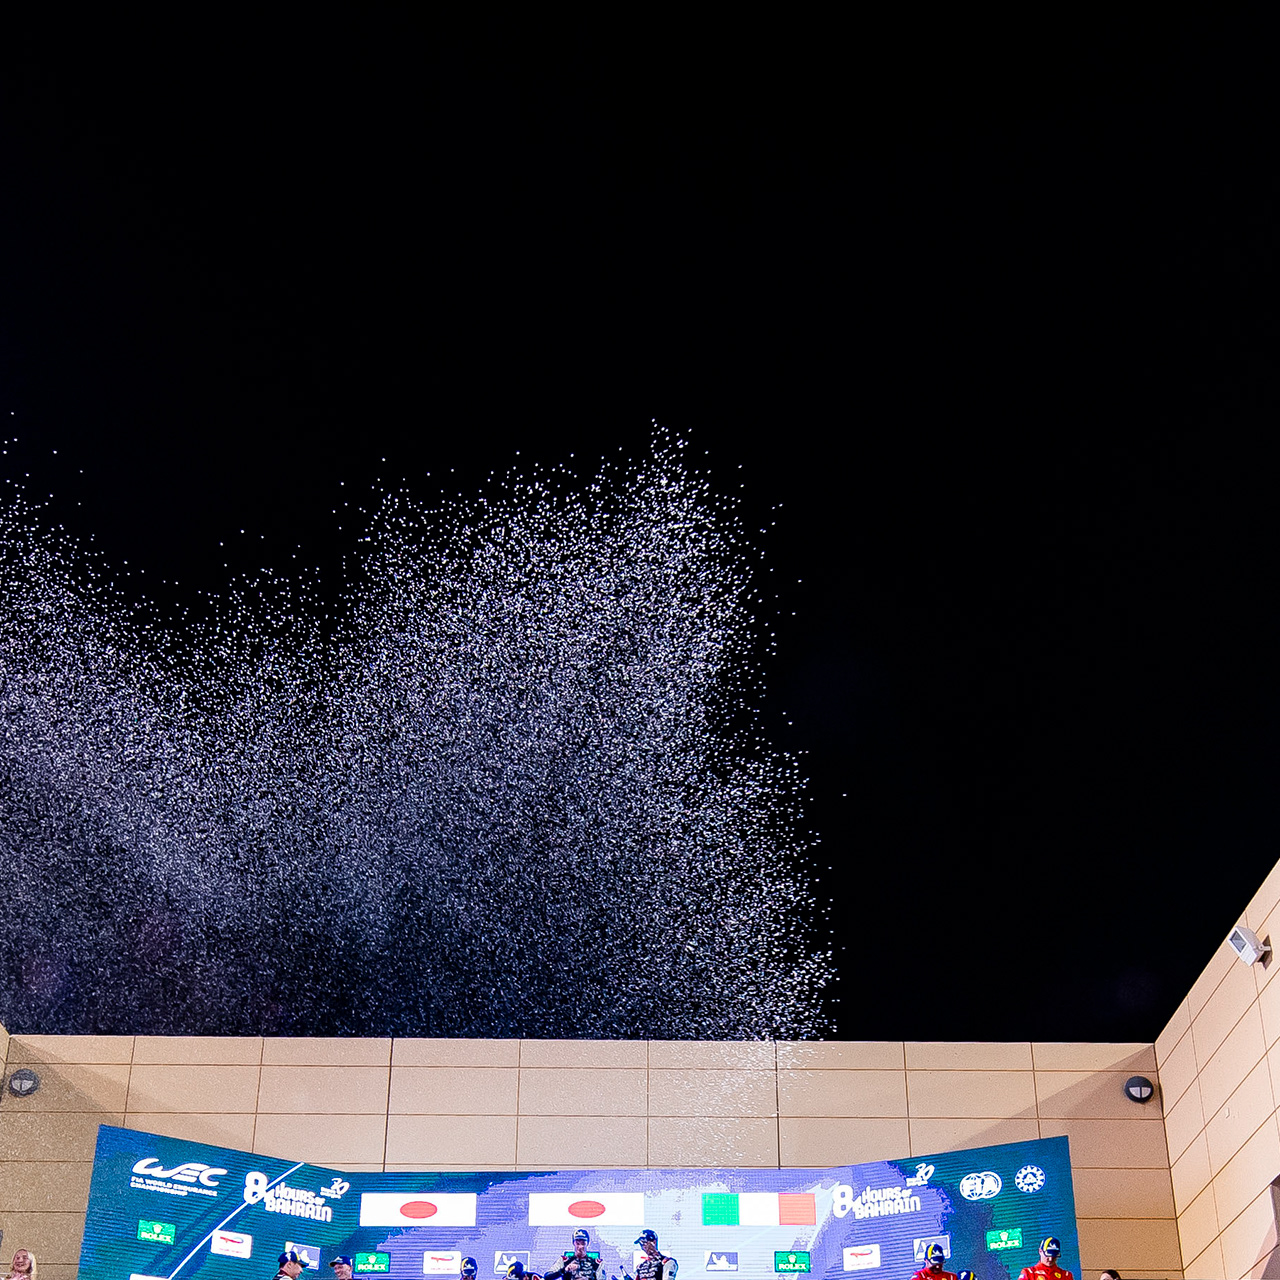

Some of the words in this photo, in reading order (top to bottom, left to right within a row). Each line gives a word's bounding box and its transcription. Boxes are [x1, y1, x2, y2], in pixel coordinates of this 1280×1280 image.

[131, 1157, 228, 1187] WEC
[243, 1171, 269, 1205] 8
[275, 1182, 316, 1203] HOURS
[861, 1186, 902, 1204] HOURS
[265, 1196, 332, 1223] BAHRAIN
[832, 1184, 854, 1218] 8
[854, 1196, 921, 1219] BAHRAIN
[140, 1231, 172, 1243] ROLEX
[989, 1239, 1020, 1250] ROLEX
[357, 1263, 386, 1271] ROLEX
[778, 1263, 807, 1271] ROLEX
